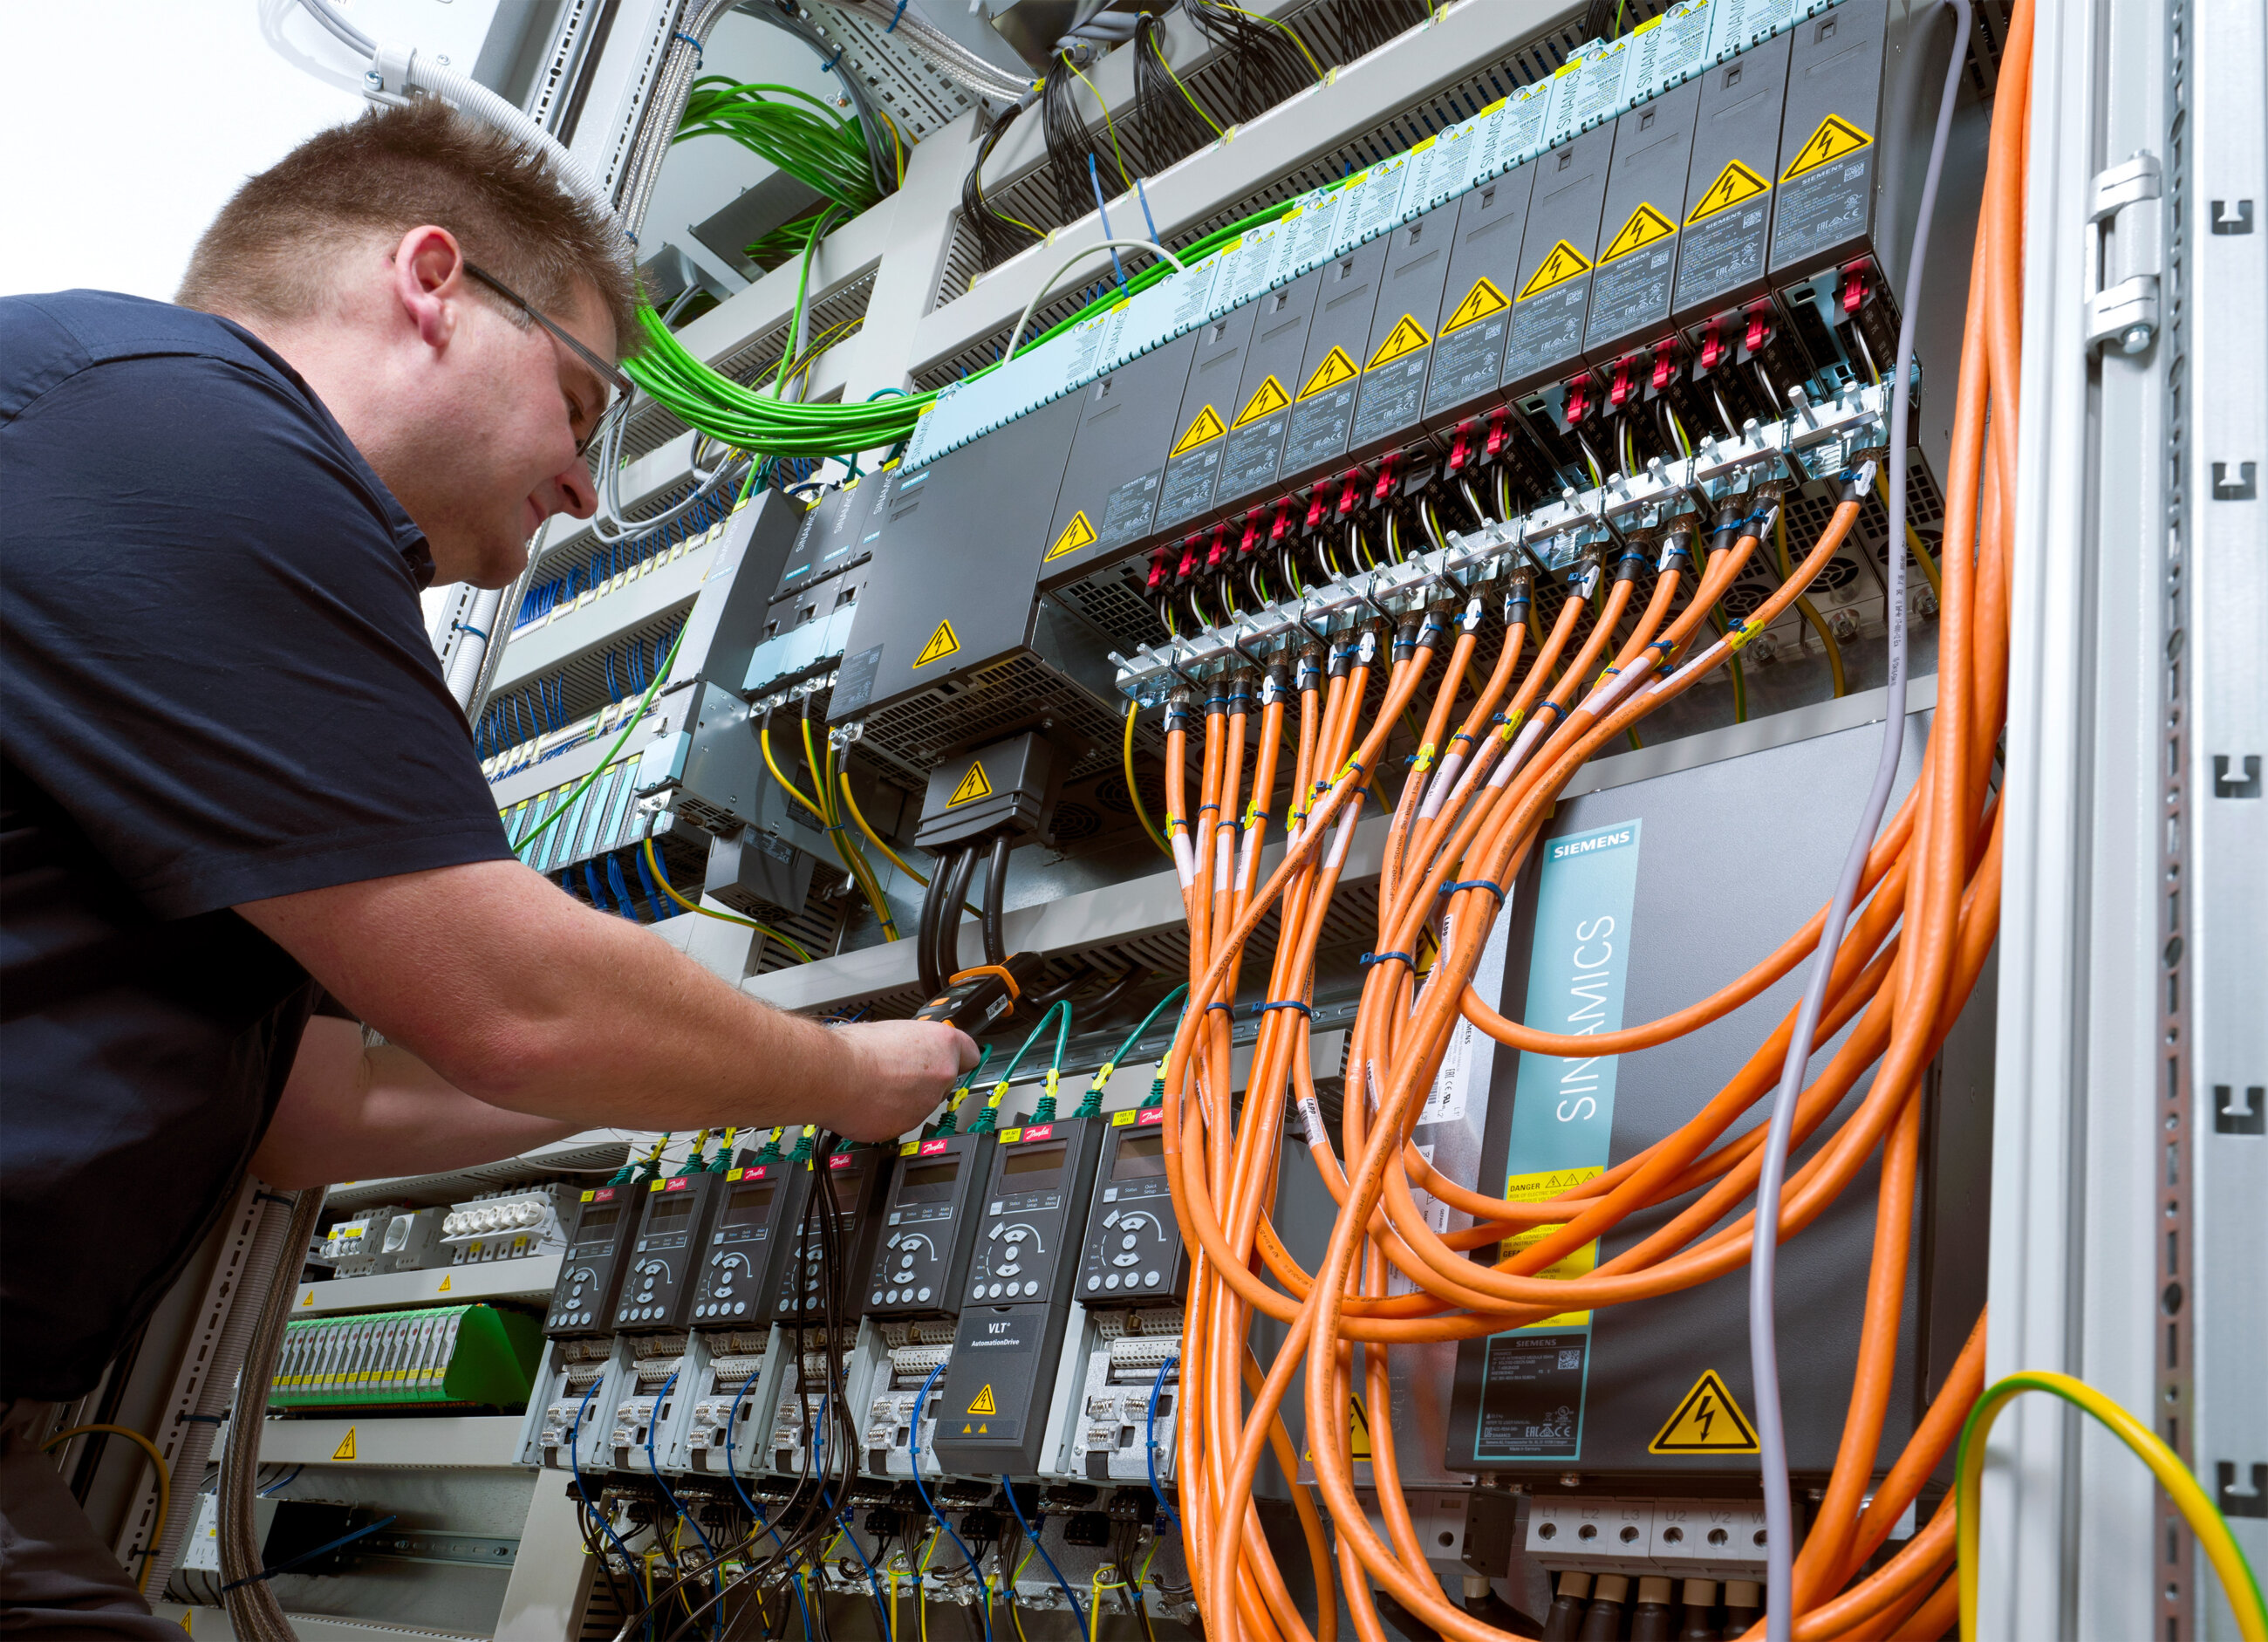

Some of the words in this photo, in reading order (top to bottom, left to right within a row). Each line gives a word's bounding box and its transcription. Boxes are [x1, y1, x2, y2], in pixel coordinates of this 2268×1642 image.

[1637, 26, 1662, 89] SINAMICS
[1557, 69, 1581, 130] SINAMICS
[1480, 108, 1506, 169] SINAMICS
[1411, 148, 1436, 208] SINAMICS
[1801, 162, 1844, 185] SIEMENS
[1342, 182, 1367, 240] SINAMICS
[1705, 210, 1743, 230] SIEMENS
[1278, 216, 1302, 273] SINAMICS
[1616, 250, 1650, 270] SIEMENS
[1219, 250, 1243, 306] SINAMICS
[1532, 287, 1568, 307] SIEMENS
[1453, 322, 1486, 340] SIEMENS
[1379, 359, 1408, 375] SIEMENS
[1308, 391, 1337, 407] SIEMENS
[912, 410, 934, 460] SINAMICS
[1243, 420, 1270, 434] SIEMENS
[1181, 450, 1206, 465] SIEMENS
[903, 474, 928, 489] SIEMENS
[1122, 475, 1147, 489] SIEMENS
[873, 468, 897, 516] SINAMICS
[834, 488, 857, 535] SINAMICS
[796, 507, 819, 553] SINAMICS
[1554, 831, 1629, 859] SIEMENS
[1306, 1098, 1316, 1115] LAPP
[1026, 1128, 1050, 1140] Danfoss
[1510, 1182, 1540, 1193] DANGER
[971, 1338, 1020, 1347] AutomationDrive
[1516, 1339, 1557, 1348] SIEMENS
[1541, 1506, 1559, 1518] L1
[1581, 1508, 1600, 1519] L2
[1622, 1509, 1640, 1520] L3
[1664, 1510, 1687, 1522] U2
[1709, 1511, 1732, 1523] V2
[1751, 1512, 1766, 1524] W
